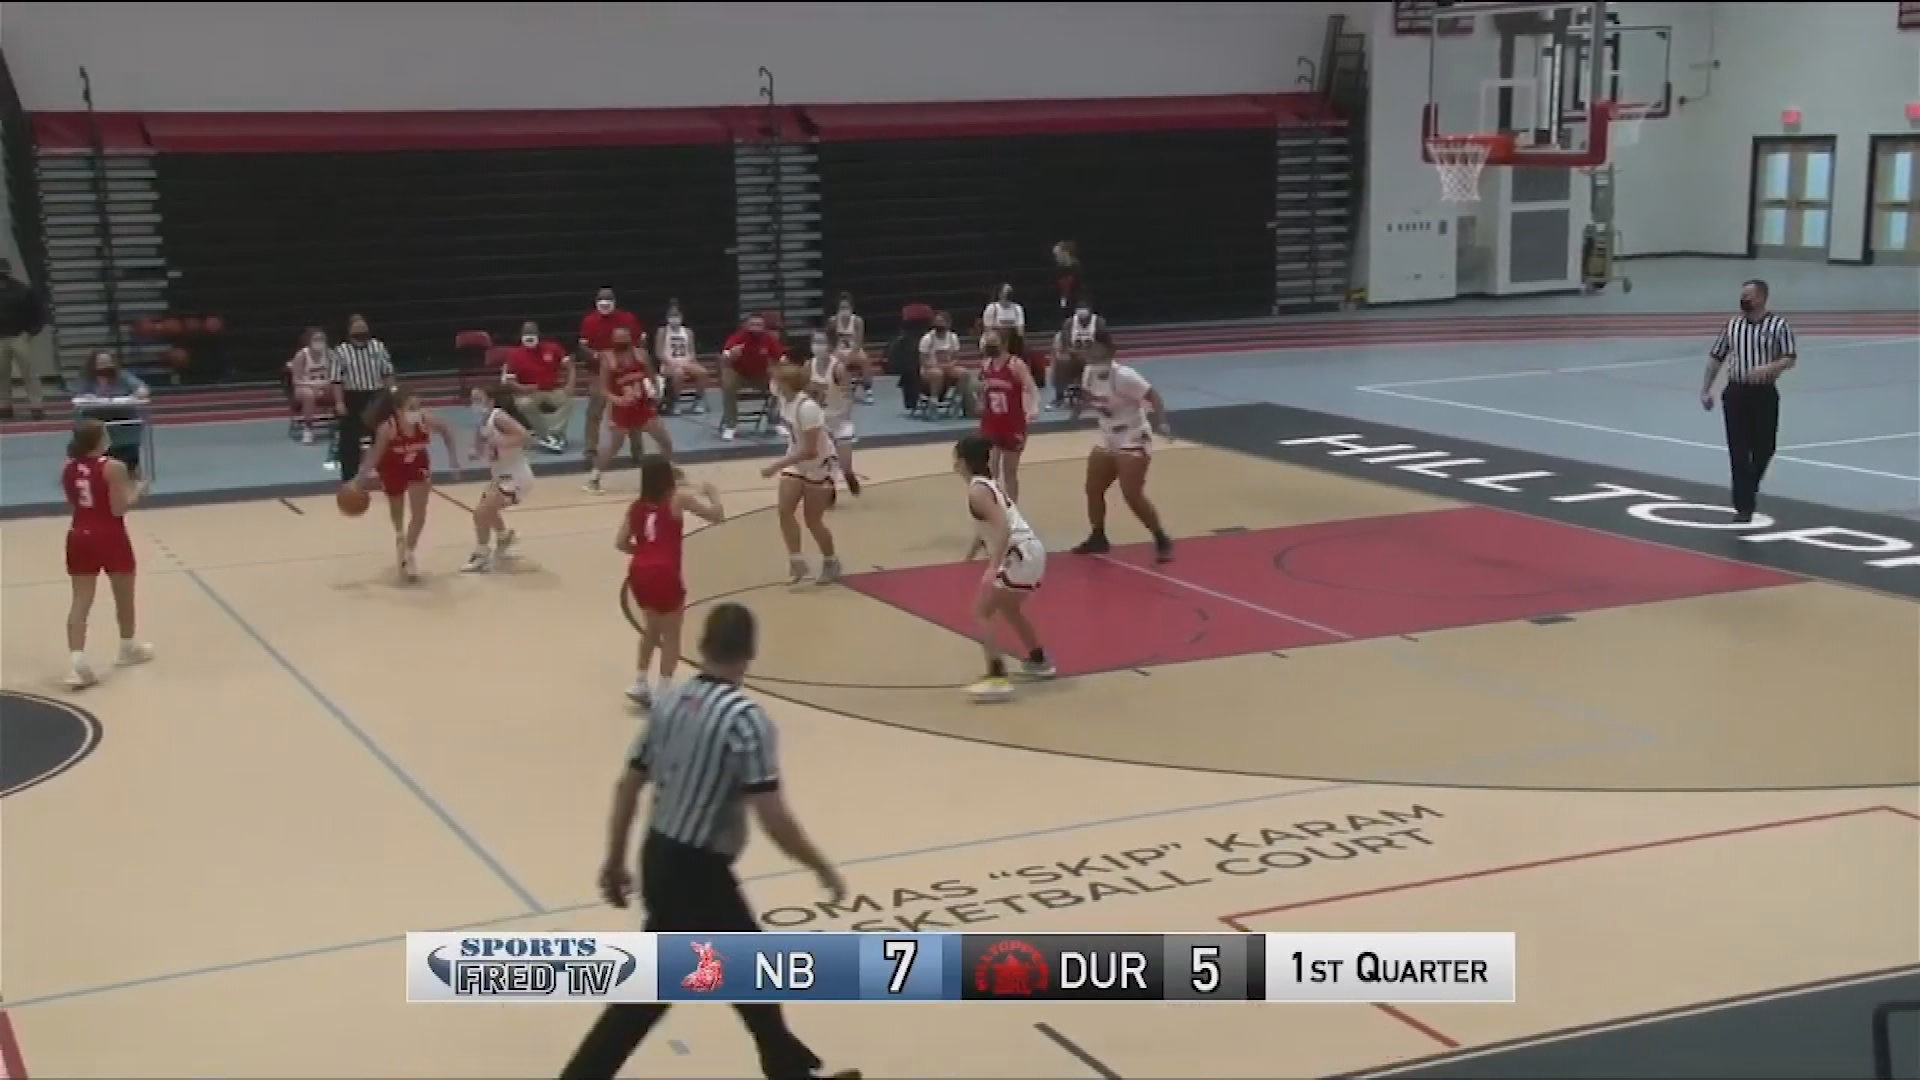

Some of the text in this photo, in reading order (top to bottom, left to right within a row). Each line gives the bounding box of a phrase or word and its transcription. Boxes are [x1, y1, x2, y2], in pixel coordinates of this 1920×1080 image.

[75, 479, 94, 507] 3
[760, 879, 978, 927] OMAS
[1204, 804, 1444, 852] KARAM
[851, 828, 1434, 932] SKETBALL COURT
